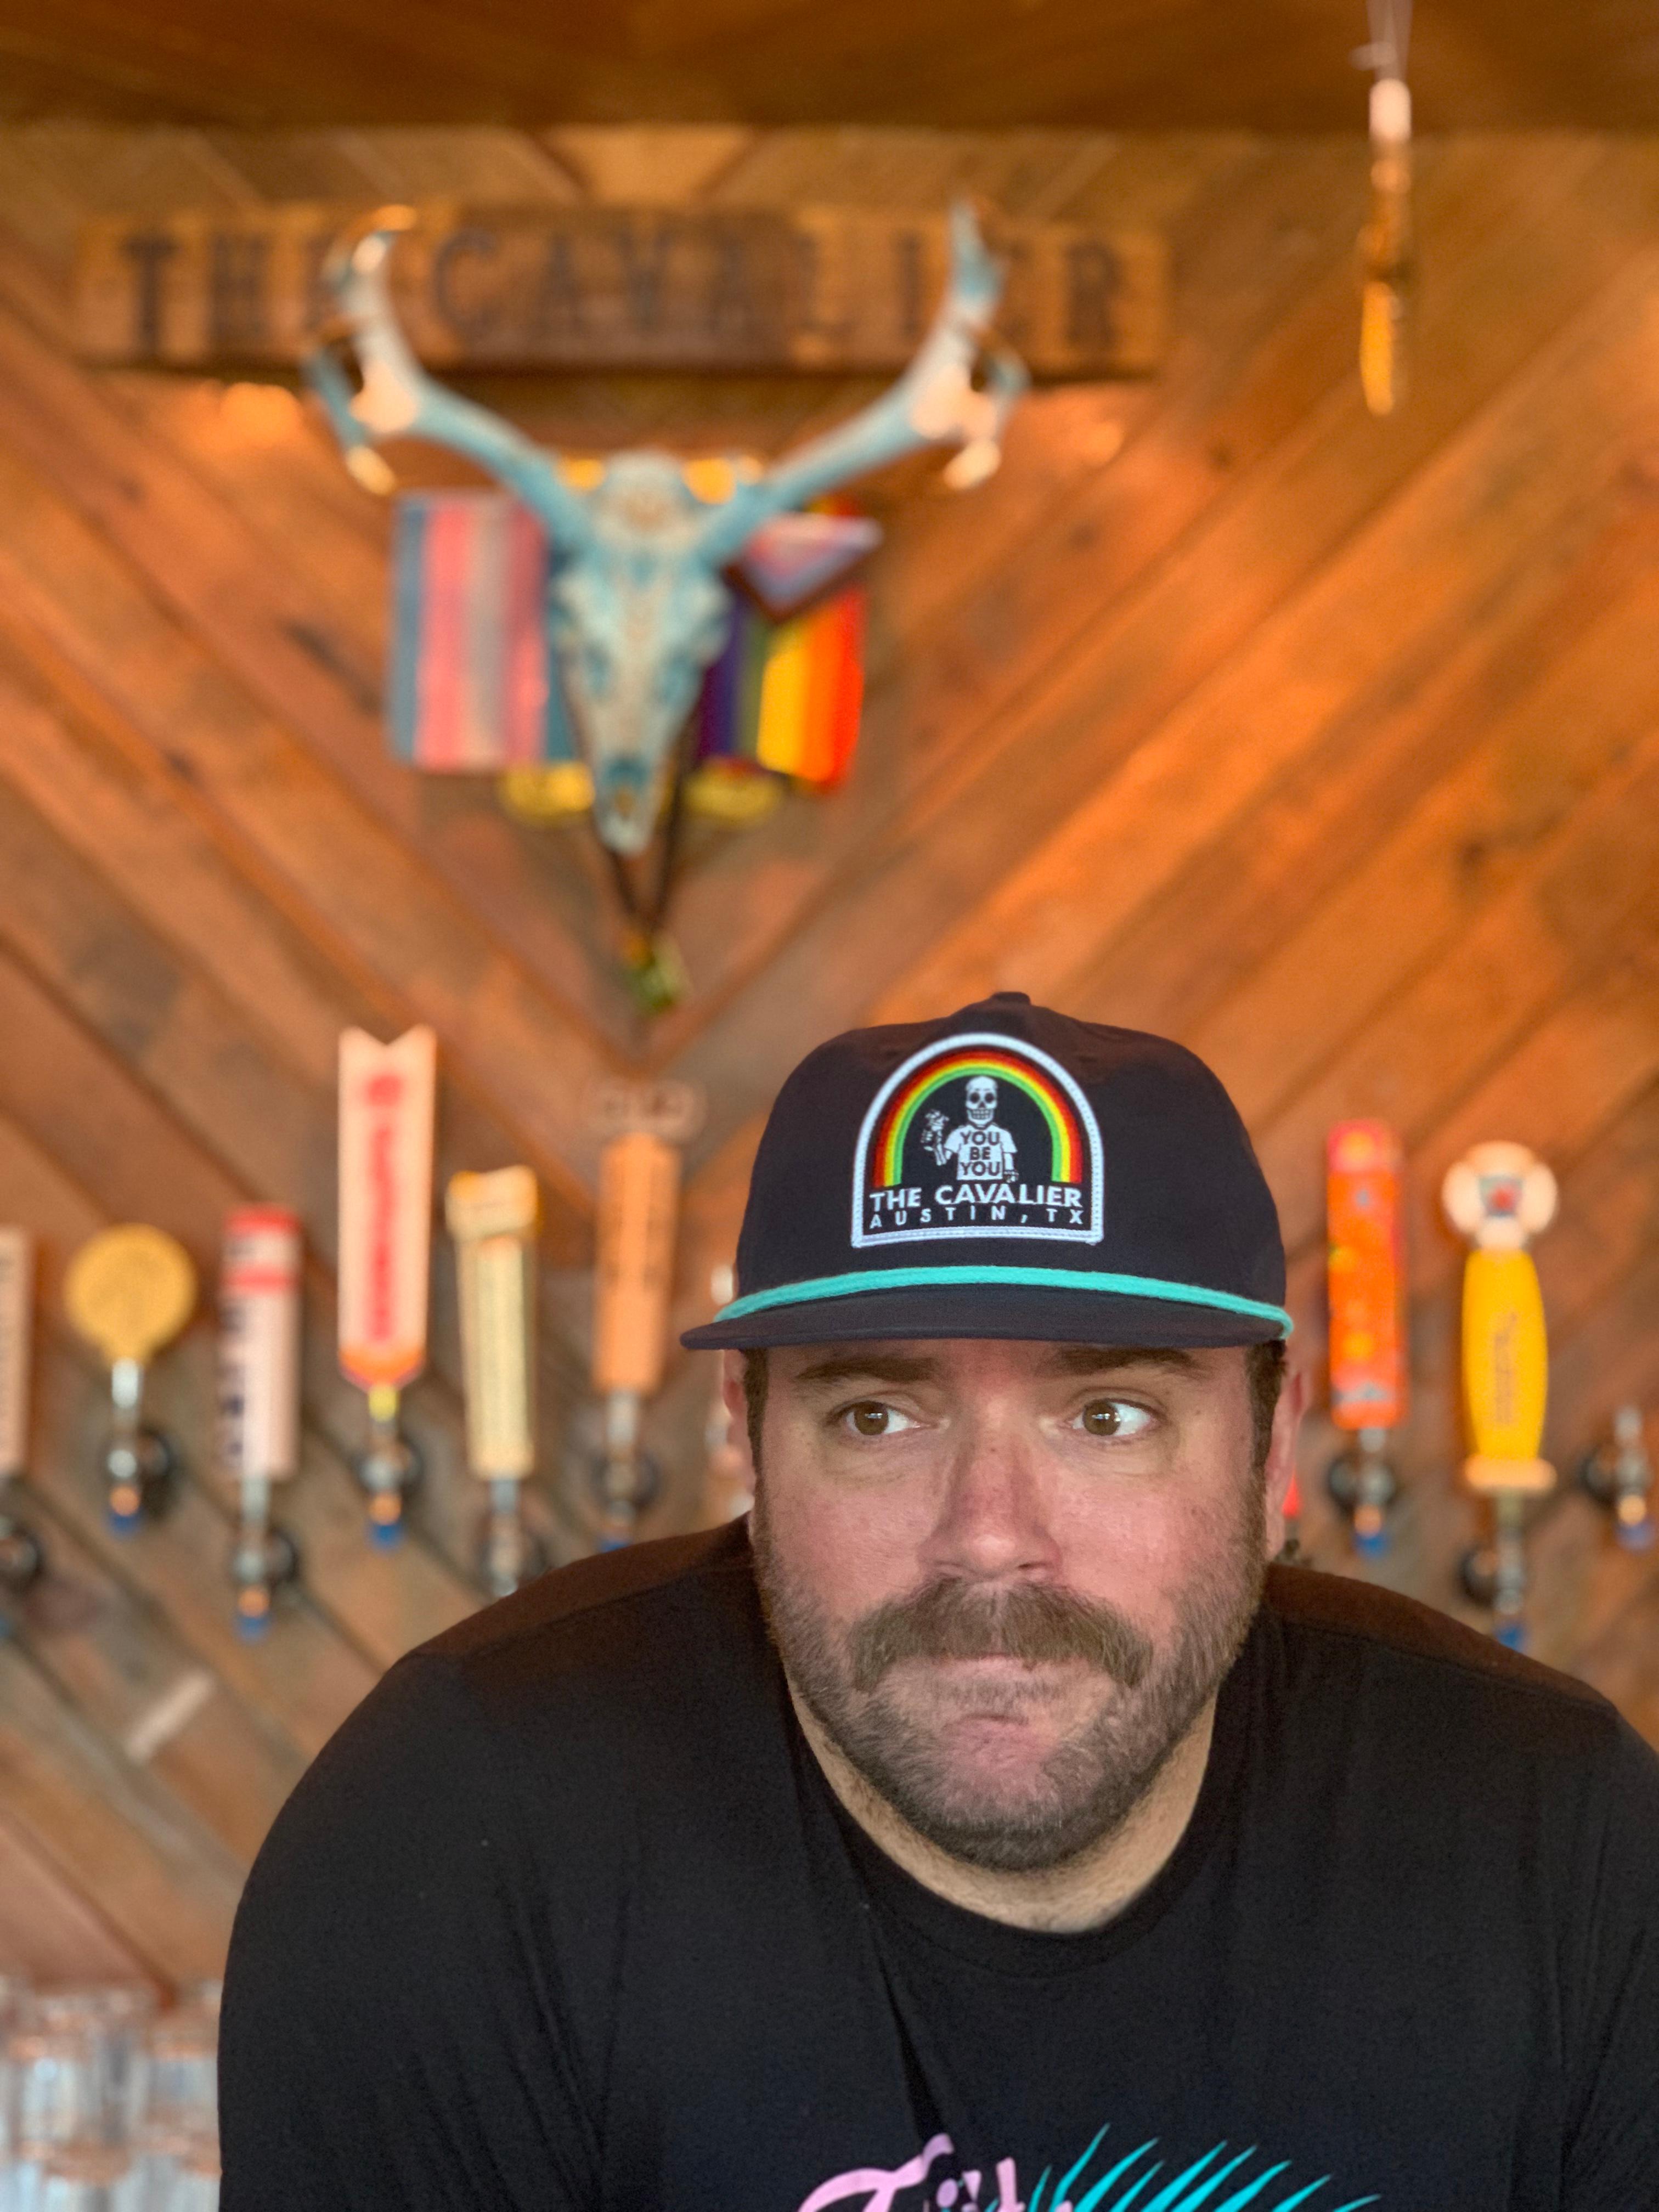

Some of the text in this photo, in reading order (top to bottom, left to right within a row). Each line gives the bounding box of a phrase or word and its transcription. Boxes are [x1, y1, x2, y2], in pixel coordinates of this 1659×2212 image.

[960, 1131, 1000, 1146] YOU
[969, 1147, 991, 1160] BE
[960, 1161, 1001, 1177] YOU
[869, 1183, 1083, 1212] THE CAVALIER
[869, 1205, 1084, 1229] AUSTIN, TX
